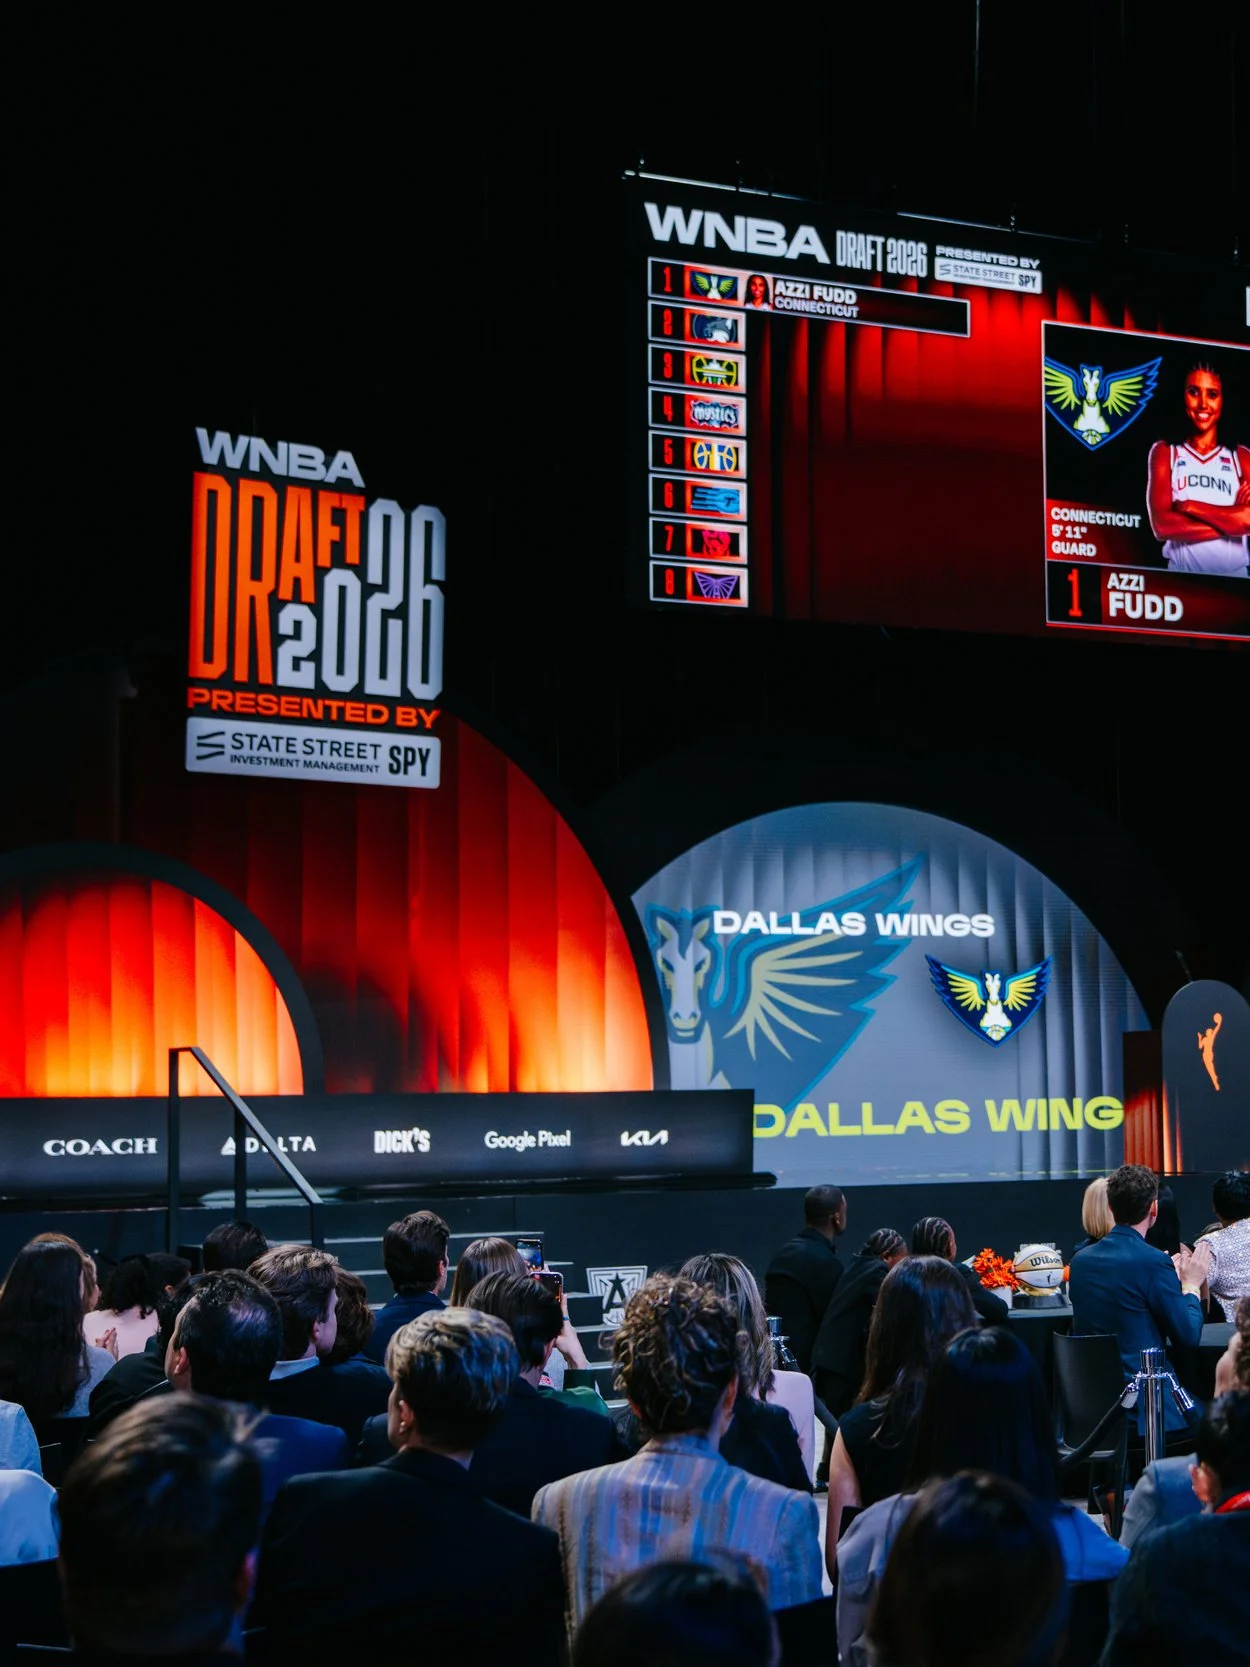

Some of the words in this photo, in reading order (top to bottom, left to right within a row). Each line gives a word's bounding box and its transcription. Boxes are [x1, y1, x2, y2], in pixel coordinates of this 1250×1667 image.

[644, 202, 830, 264] WNBA
[836, 230, 886, 272] DRAFT
[886, 237, 928, 278] 2026
[936, 245, 1018, 267] PRESENTED
[1019, 257, 1041, 270] BY
[663, 265, 672, 293] 1
[953, 264, 980, 276] STATE
[982, 269, 1015, 281] STREET
[1018, 273, 1037, 288] SPY
[775, 280, 810, 299] AZZI
[813, 285, 858, 305] FUDD
[774, 296, 860, 318] CONNECTICUT
[663, 308, 673, 335] 2
[663, 352, 673, 379] 3
[663, 395, 673, 422] 4
[195, 427, 366, 489] WNBA
[663, 438, 673, 465] 5
[664, 482, 674, 508] 6
[1177, 474, 1232, 496] UCONN
[1051, 507, 1141, 528] CONNECTICUT
[664, 525, 674, 552] 7
[1051, 540, 1097, 557] GUARD
[188, 471, 366, 686] DRAFT
[665, 568, 674, 595] 8
[1107, 572, 1145, 591] AZZI
[276, 498, 447, 701] 2026
[1067, 568, 1082, 618] 1
[1109, 592, 1184, 622] FUDD
[187, 687, 390, 726] PRESENTED
[395, 707, 441, 729] BY
[230, 732, 297, 755] STATE
[302, 737, 382, 760] STREET
[230, 754, 301, 769] INVESTMENT
[303, 760, 381, 775] MANAGEMENT
[388, 744, 431, 777] SPY
[713, 911, 867, 937] DALLAS
[875, 913, 996, 938] WINGS
[753, 1098, 971, 1139] DALLAS
[985, 1096, 1125, 1132] WING
[43, 1137, 158, 1156] COACH
[245, 1136, 317, 1153] DLTA
[374, 1127, 430, 1153] DICK'S
[484, 1131, 536, 1151] Google
[537, 1129, 571, 1147] Pixel
[1030, 1255, 1062, 1267] Wilson
